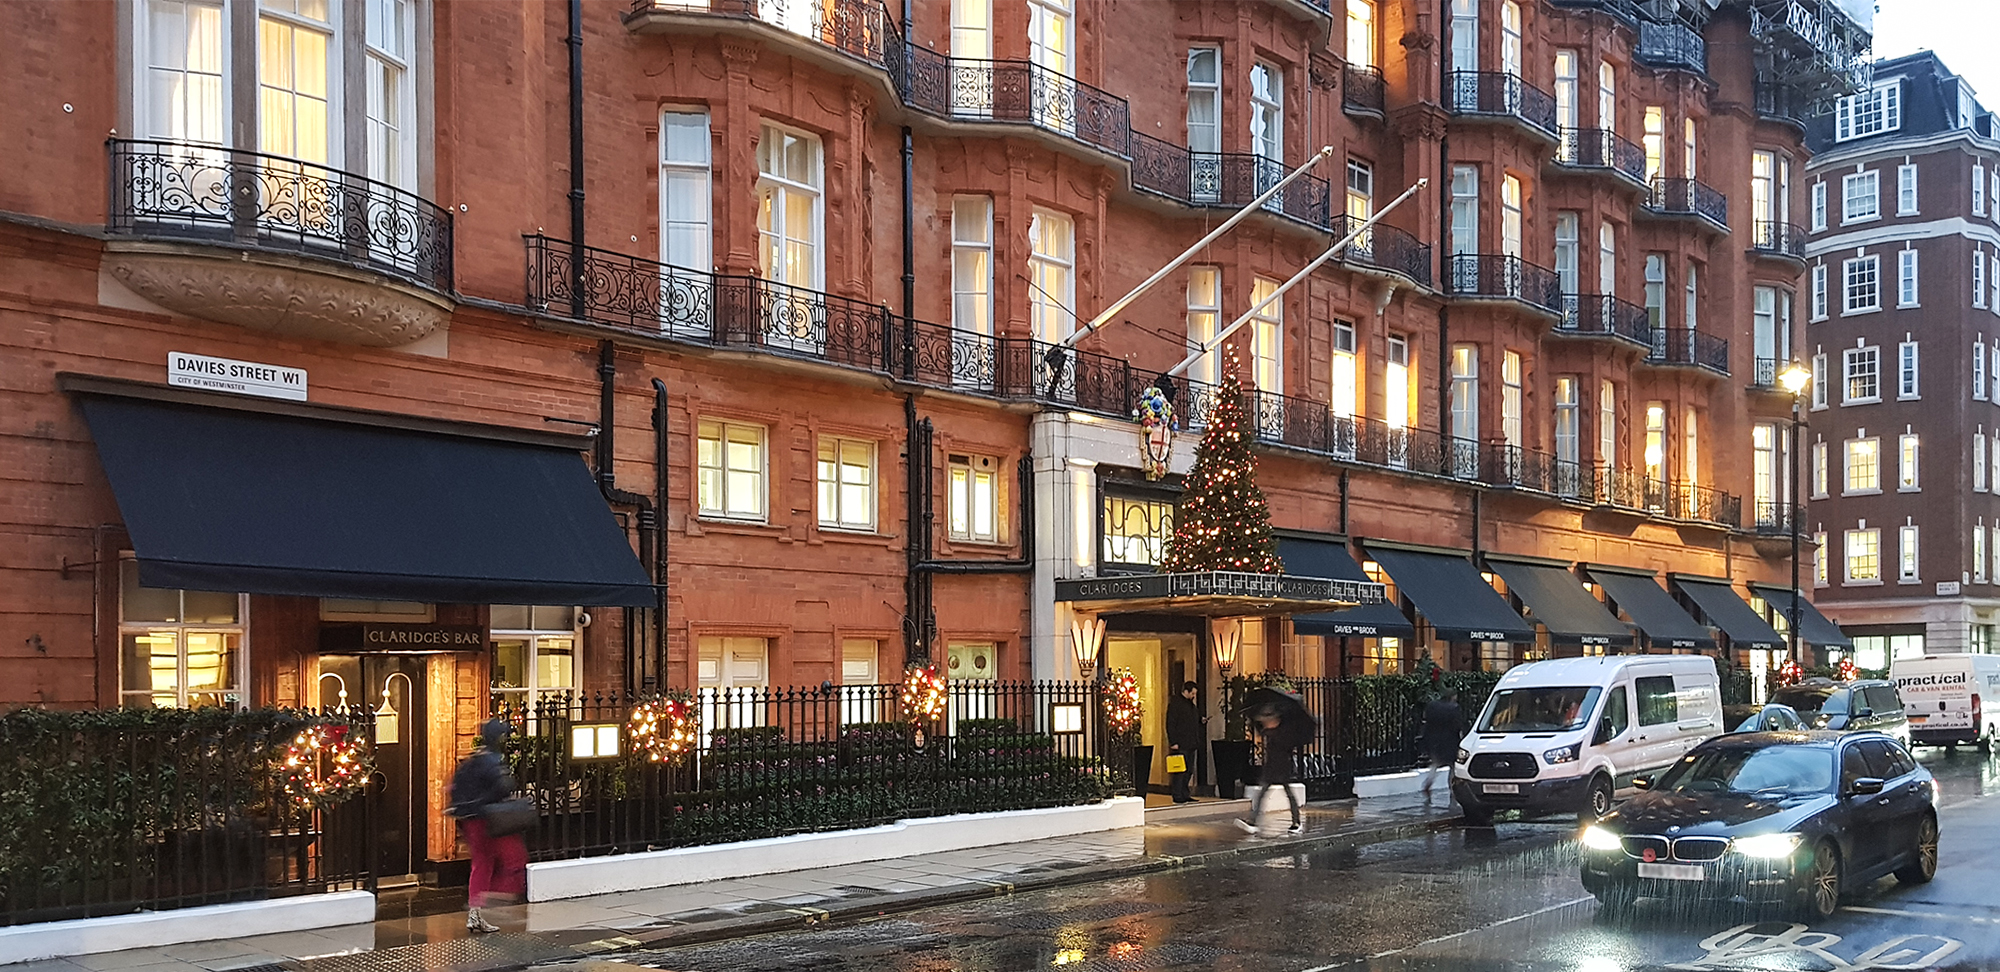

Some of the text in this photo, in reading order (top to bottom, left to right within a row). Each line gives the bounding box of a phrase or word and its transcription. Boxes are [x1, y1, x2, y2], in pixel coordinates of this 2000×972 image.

[177, 358, 300, 385] DAVIES STREET W1
[177, 376, 192, 384] CITY
[203, 380, 246, 391] WESTMINSTER
[1079, 582, 1142, 596] CLARIDGES
[368, 629, 480, 644] CLARIDGE'S BAR
[1334, 625, 1352, 634] DAVIES
[1359, 626, 1377, 635] BROOK
[1897, 672, 1966, 689] practical
